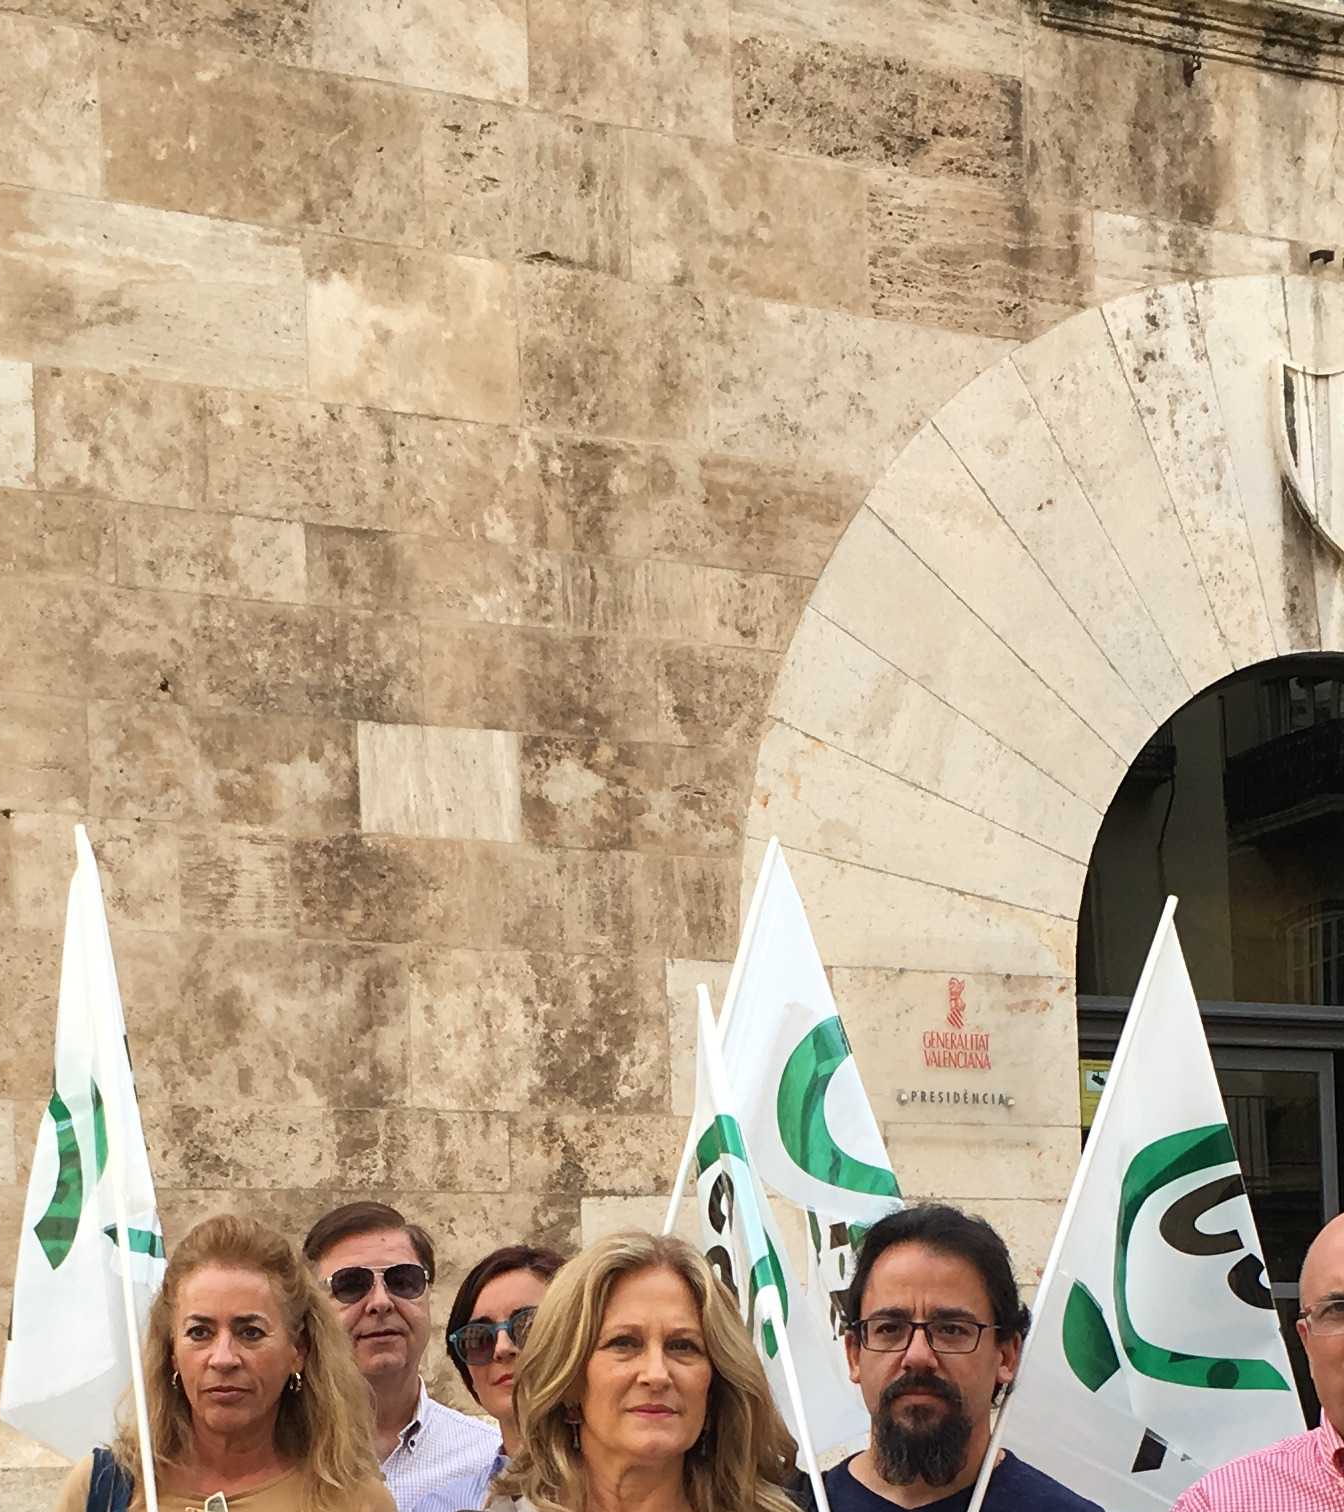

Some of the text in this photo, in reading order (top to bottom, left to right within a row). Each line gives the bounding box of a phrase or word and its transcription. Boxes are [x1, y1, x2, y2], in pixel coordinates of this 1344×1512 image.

[922, 1031, 990, 1052] GENERALITAT
[923, 1050, 992, 1070] VALENCIANA
[910, 1088, 1006, 1106] PRESIDÈNCIA
